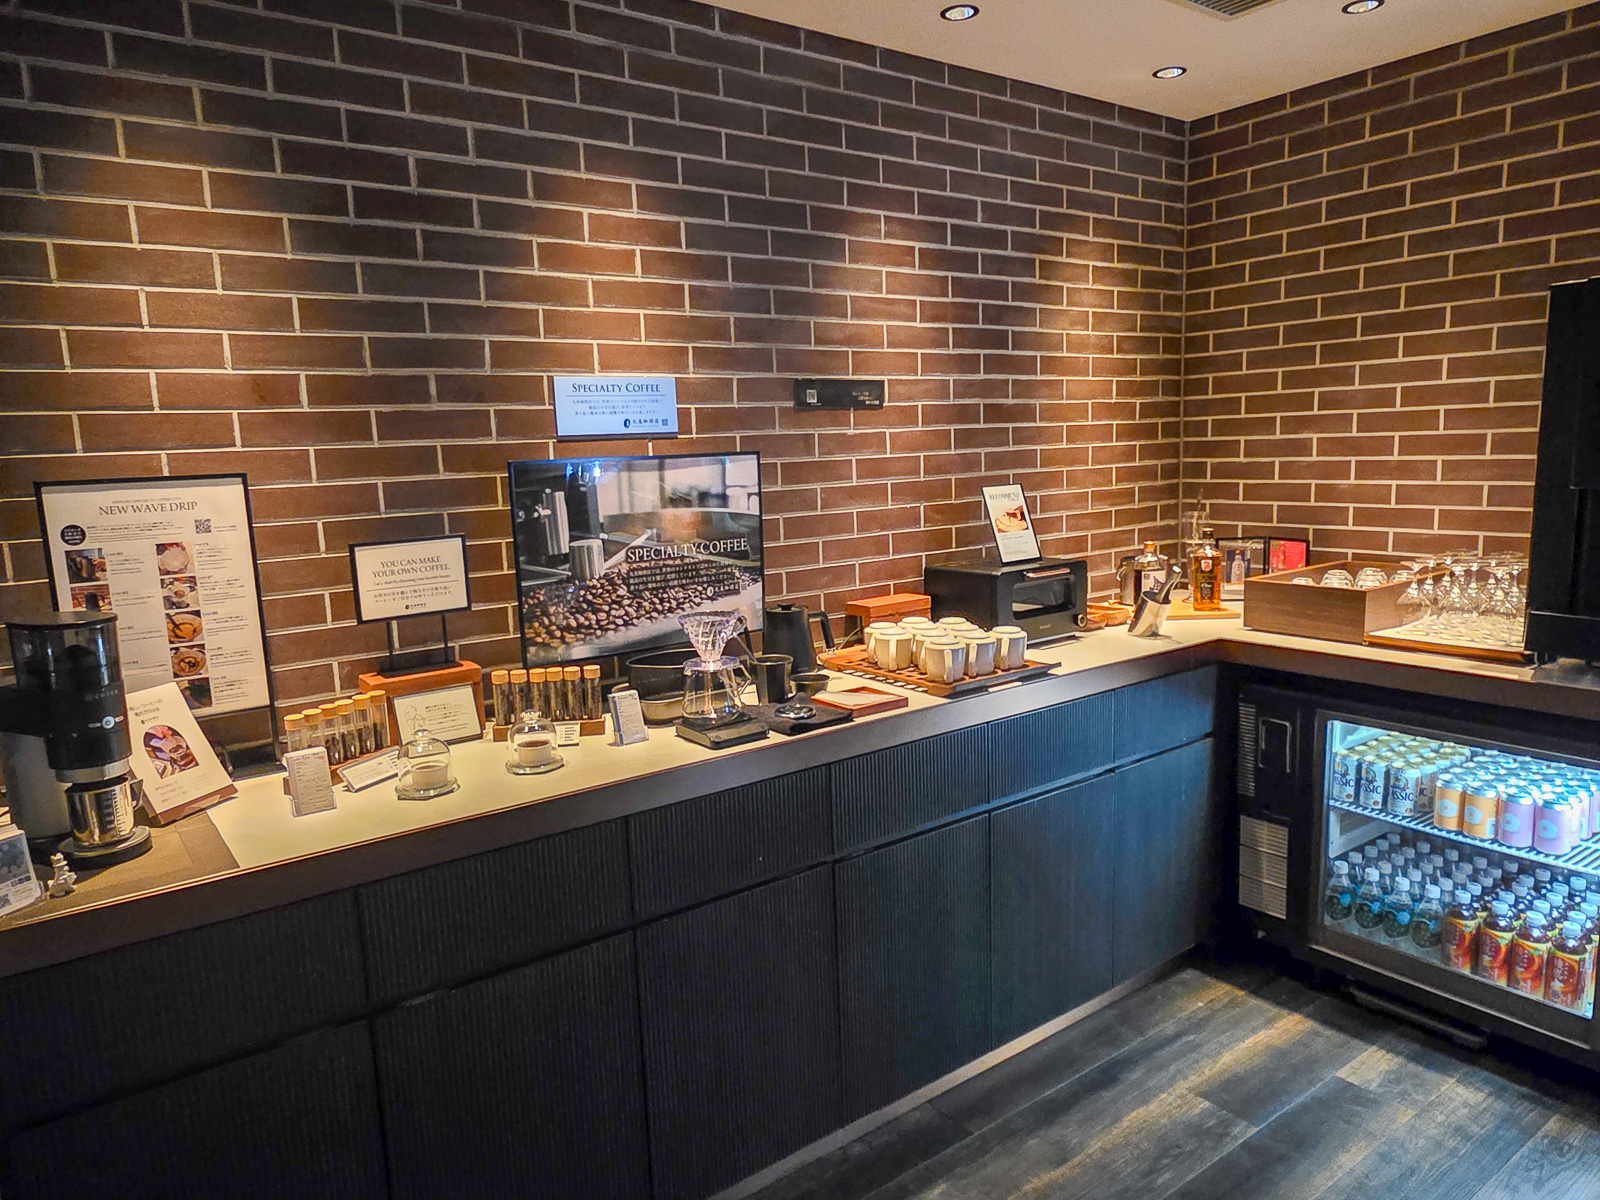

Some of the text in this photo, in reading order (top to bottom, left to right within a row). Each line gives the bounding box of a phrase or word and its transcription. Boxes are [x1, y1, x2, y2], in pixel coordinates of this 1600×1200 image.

[99, 501, 198, 516] NEW WAVE DRIP
[627, 538, 748, 562] SPECIALTY COFFEE
[380, 555, 441, 569] YOU CAN MAKE
[372, 563, 450, 578] YOUR OWN COFFEE
